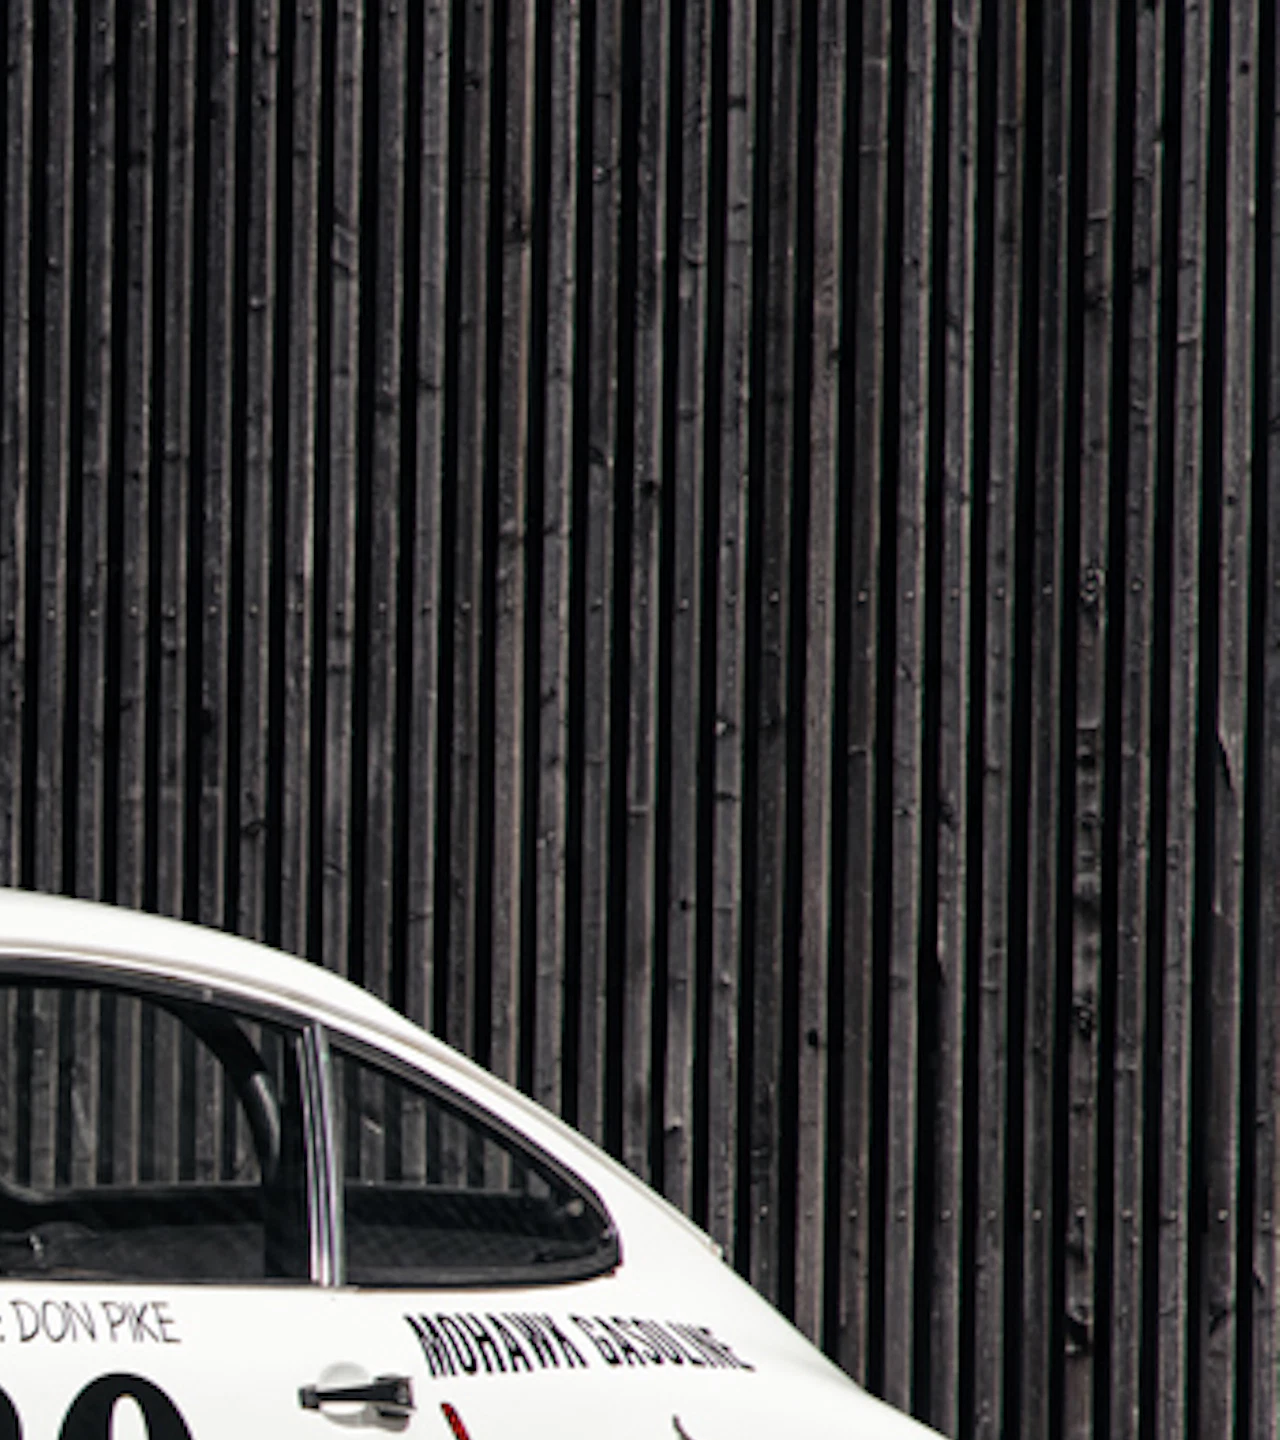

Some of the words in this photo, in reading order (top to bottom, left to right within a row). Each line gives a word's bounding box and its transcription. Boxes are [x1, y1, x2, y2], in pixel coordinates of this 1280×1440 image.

[9, 1299, 97, 1344] DON
[100, 1300, 182, 1345] PIKE
[403, 1312, 589, 1379] MOHAWK
[567, 1314, 756, 1372] GASOLINE
